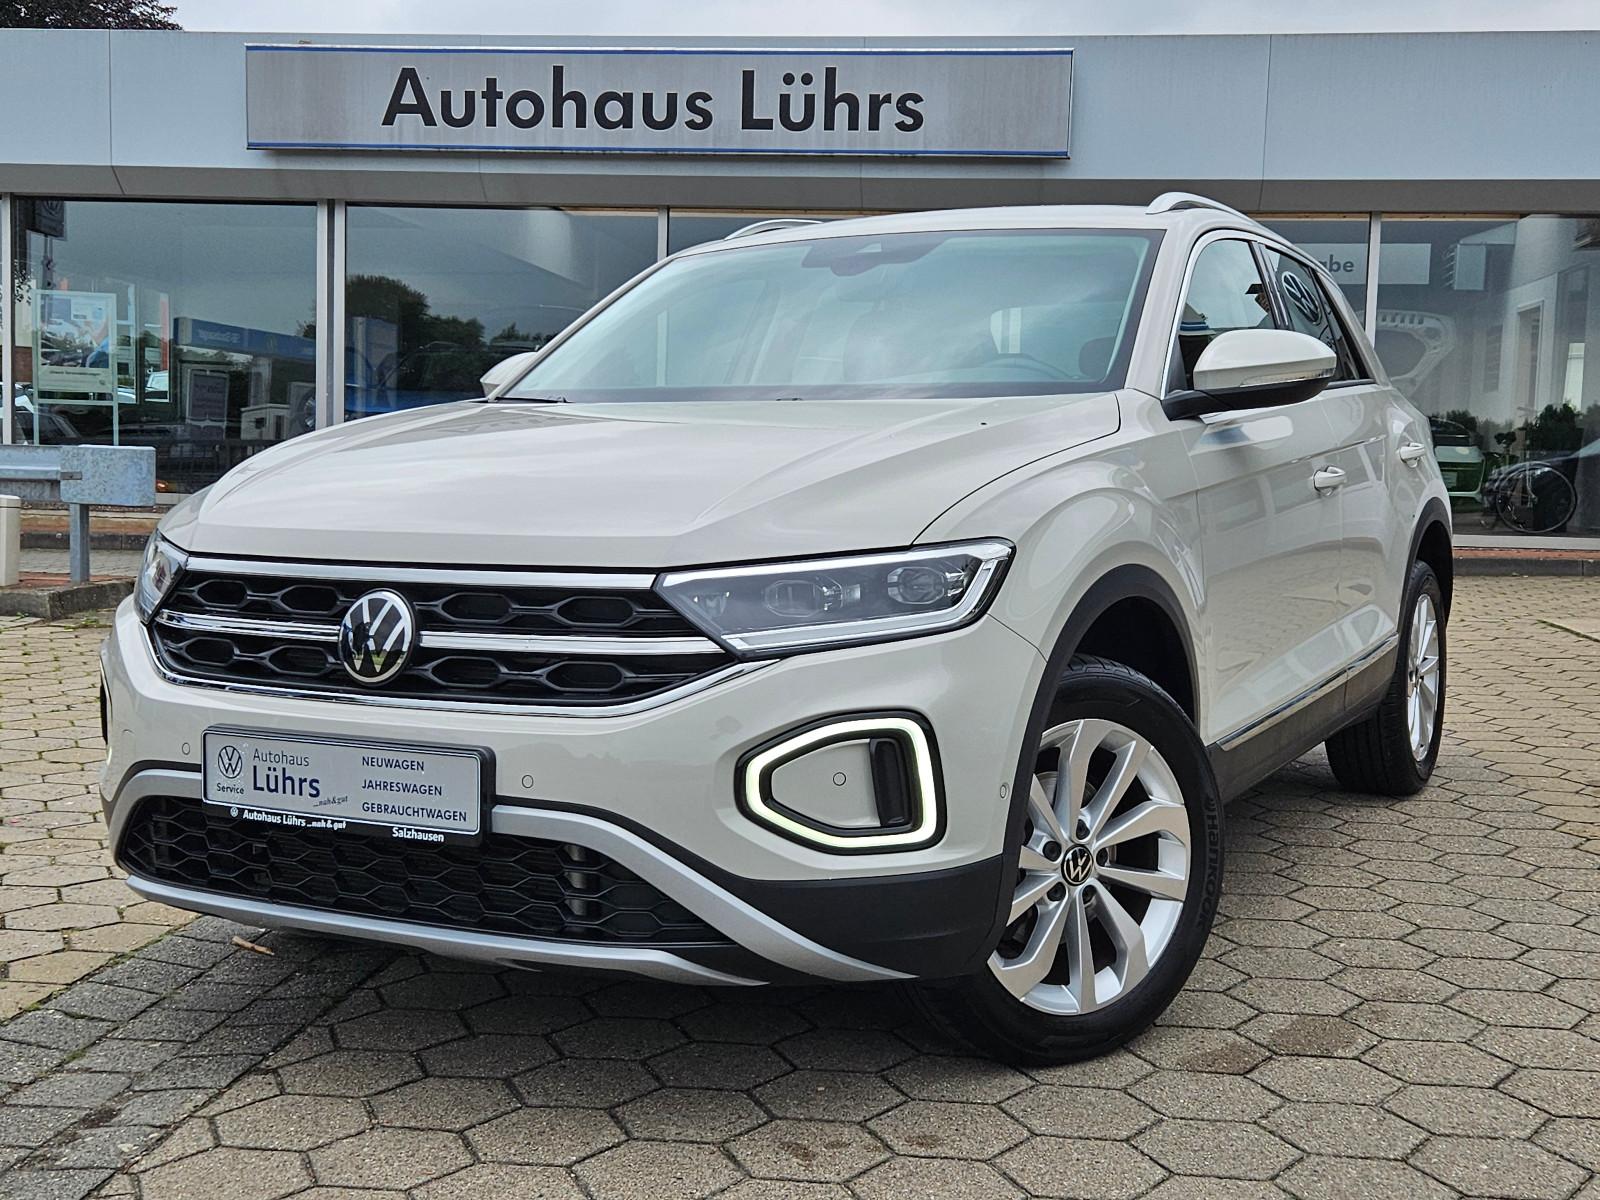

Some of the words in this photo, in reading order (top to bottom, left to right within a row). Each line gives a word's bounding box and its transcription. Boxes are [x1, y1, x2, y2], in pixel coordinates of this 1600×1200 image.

[381, 66, 713, 130] Autohaus
[740, 66, 925, 132] Lührs
[253, 748, 310, 766] Autohaus
[362, 756, 424, 771] NEUWAGEN
[216, 783, 245, 795] Service
[253, 765, 320, 798] Lührs
[362, 779, 442, 796] JAHRESWAGEN
[243, 809, 282, 824] Autohaus
[282, 814, 306, 827] Lührs
[362, 802, 467, 822] GEBRAUCHTWAGEN
[392, 827, 445, 842] Salzhausen
